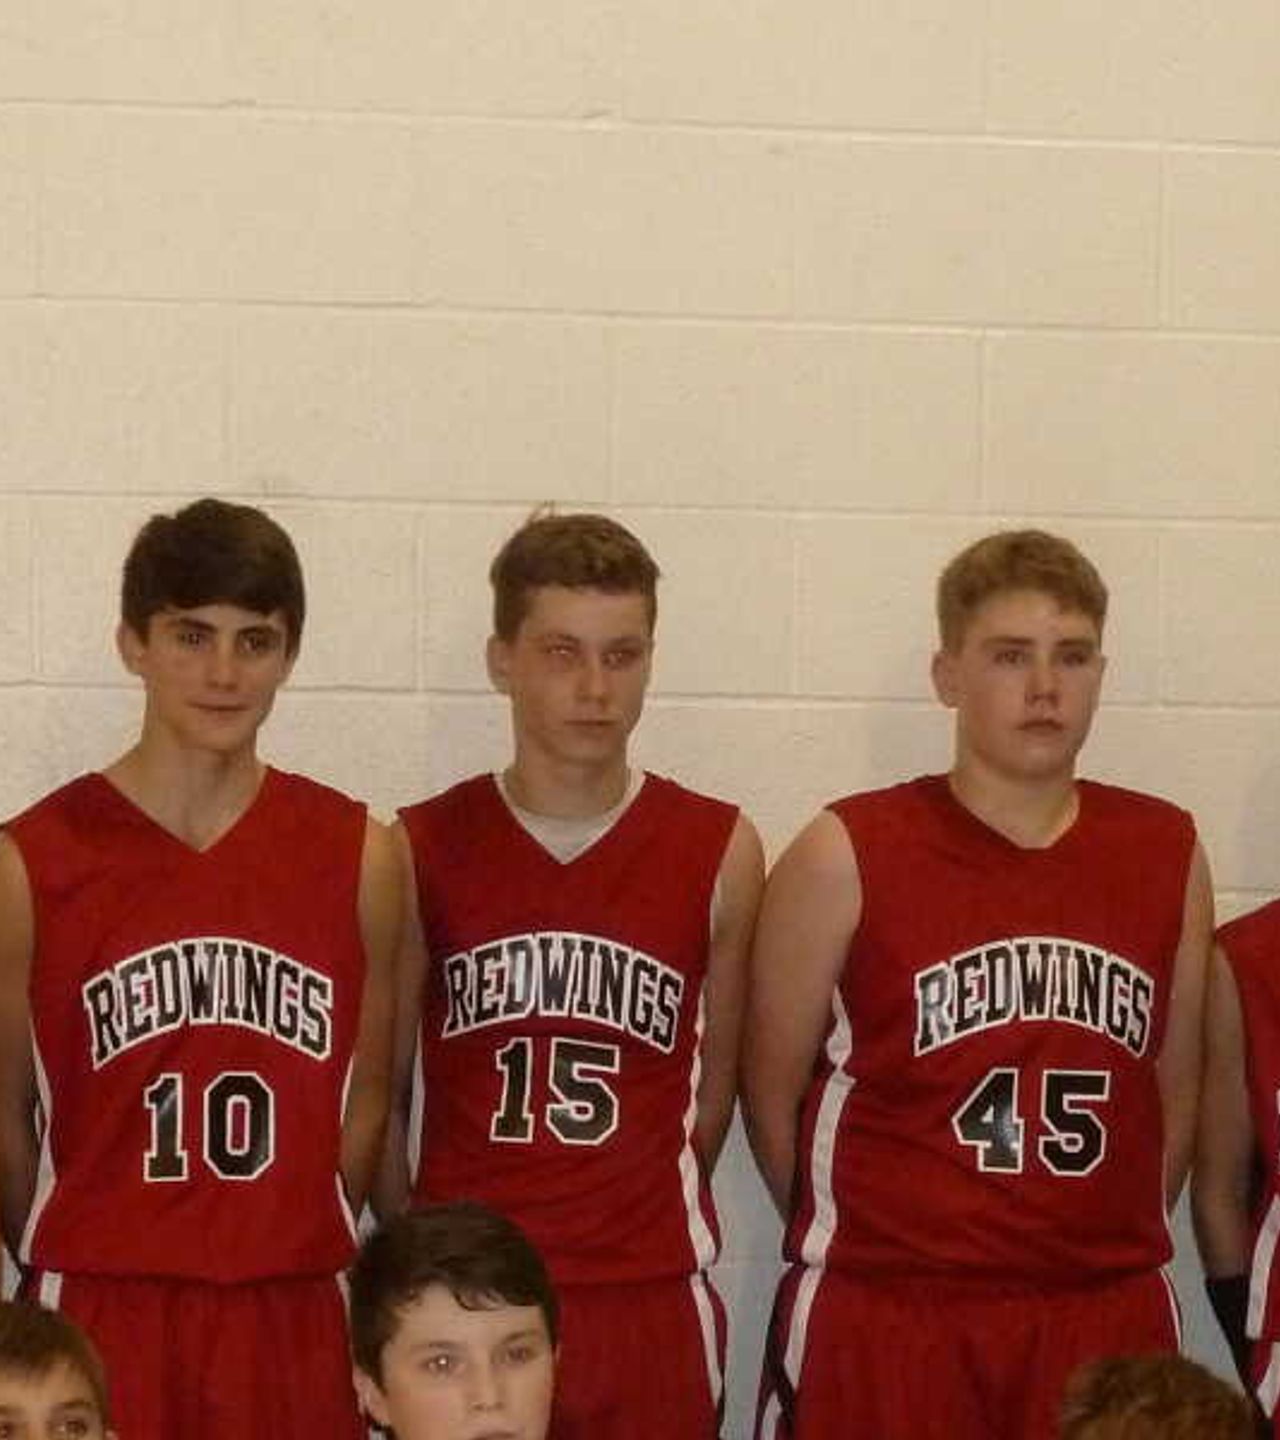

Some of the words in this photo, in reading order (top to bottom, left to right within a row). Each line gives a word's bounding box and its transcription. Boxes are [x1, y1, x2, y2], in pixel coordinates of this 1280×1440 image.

[83, 937, 333, 1072] REDWINGS
[441, 931, 685, 1055] REDWINGS
[913, 935, 1154, 1059] REDWINGS
[143, 1072, 274, 1182] 10
[489, 1036, 621, 1145] 15
[951, 1068, 1110, 1177] 45
